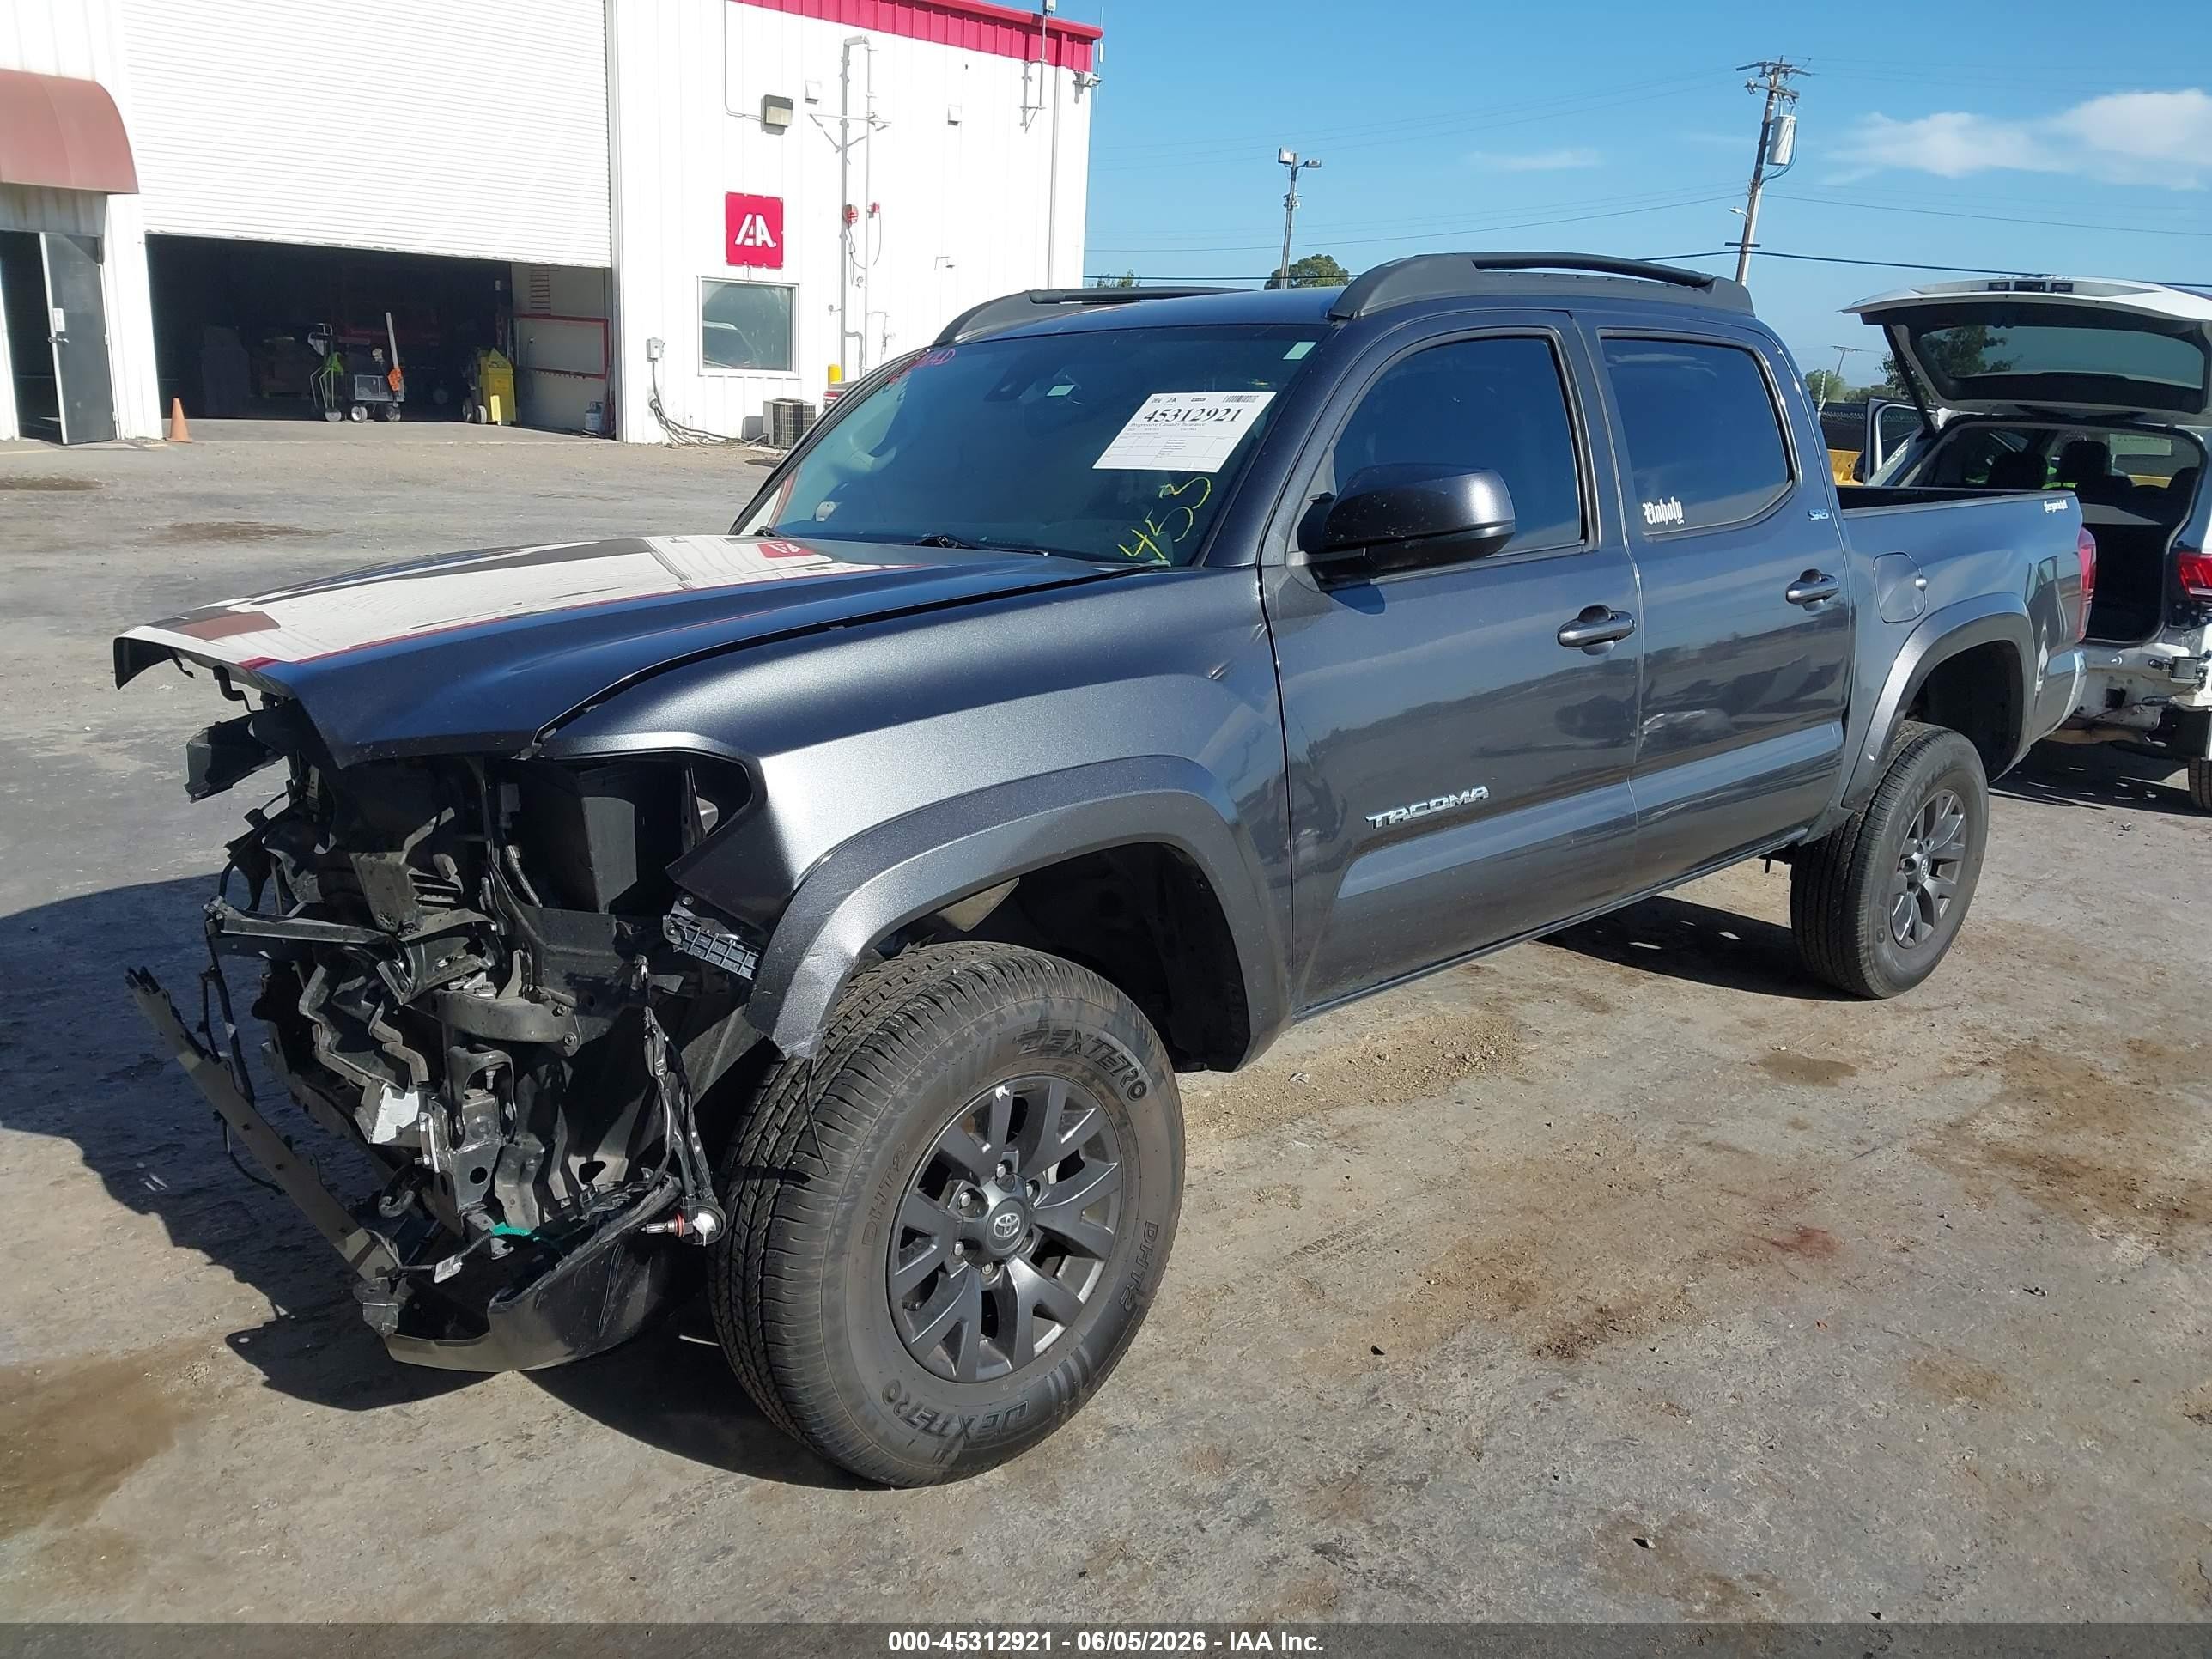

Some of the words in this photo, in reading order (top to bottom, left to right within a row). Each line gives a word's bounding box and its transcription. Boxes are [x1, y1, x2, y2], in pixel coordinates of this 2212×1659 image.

[1144, 408, 1243, 422] 45312921
[1642, 496, 1685, 525] Unholy
[1365, 785, 1489, 830] TACOMA
[881, 1378, 1030, 1441] DEXTERO
